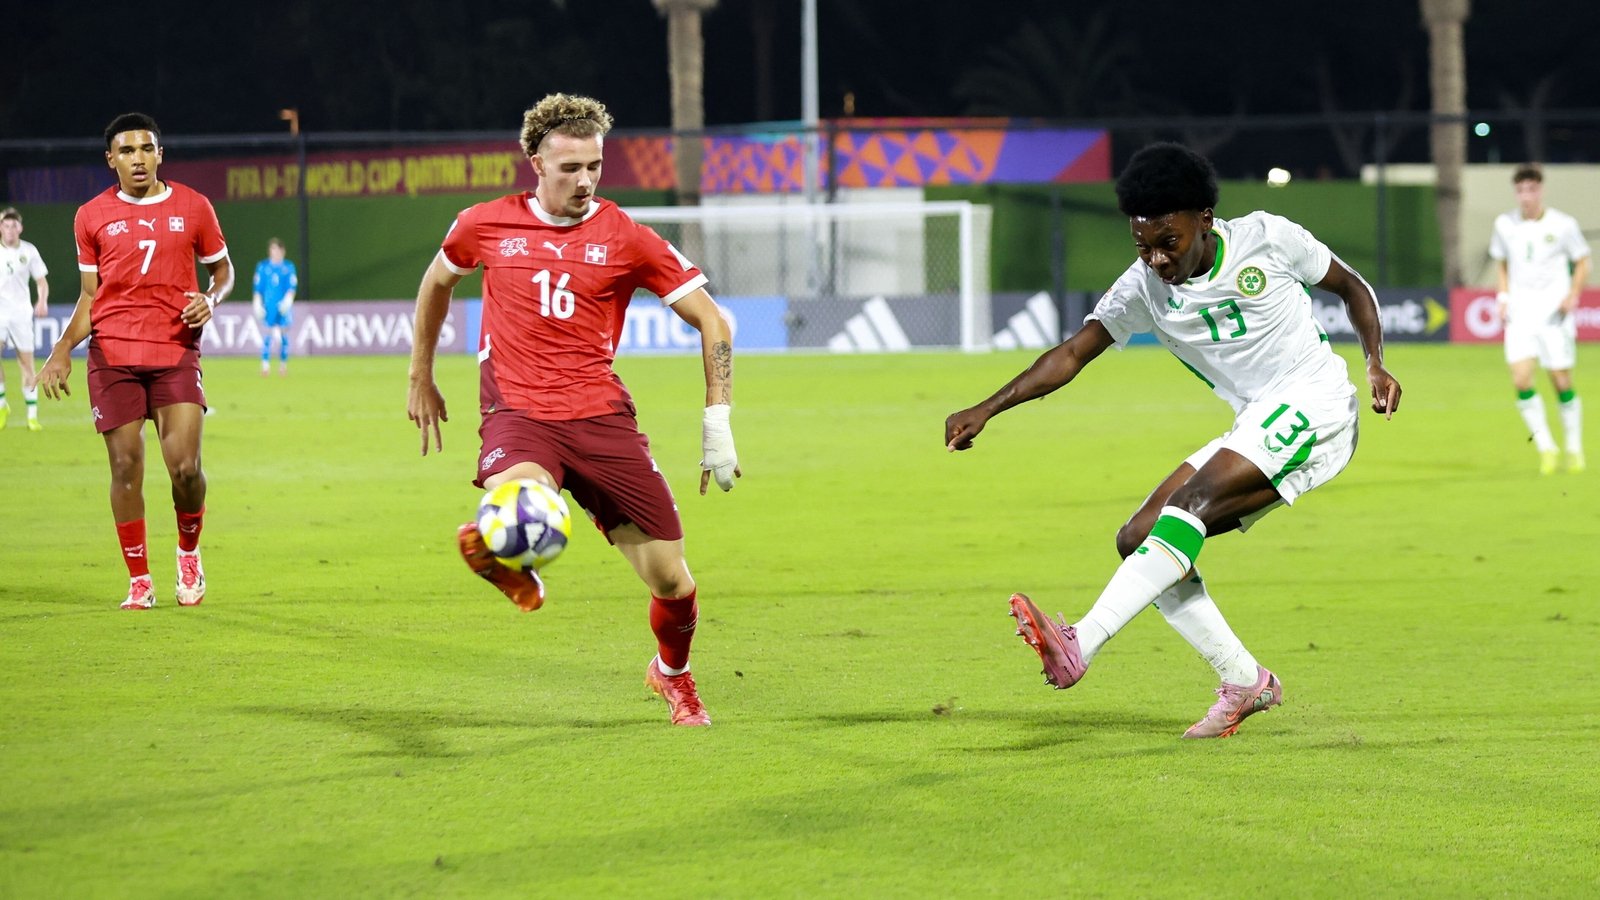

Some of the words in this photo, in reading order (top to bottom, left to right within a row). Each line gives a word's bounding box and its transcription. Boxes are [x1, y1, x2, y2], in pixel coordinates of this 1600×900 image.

[305, 161, 365, 195] WORLD
[367, 158, 401, 193] CUP
[138, 239, 156, 275] 7
[531, 269, 575, 319] 16
[296, 312, 456, 348] AIRWAS
[1198, 300, 1247, 342] 13
[1260, 403, 1310, 446] 13
